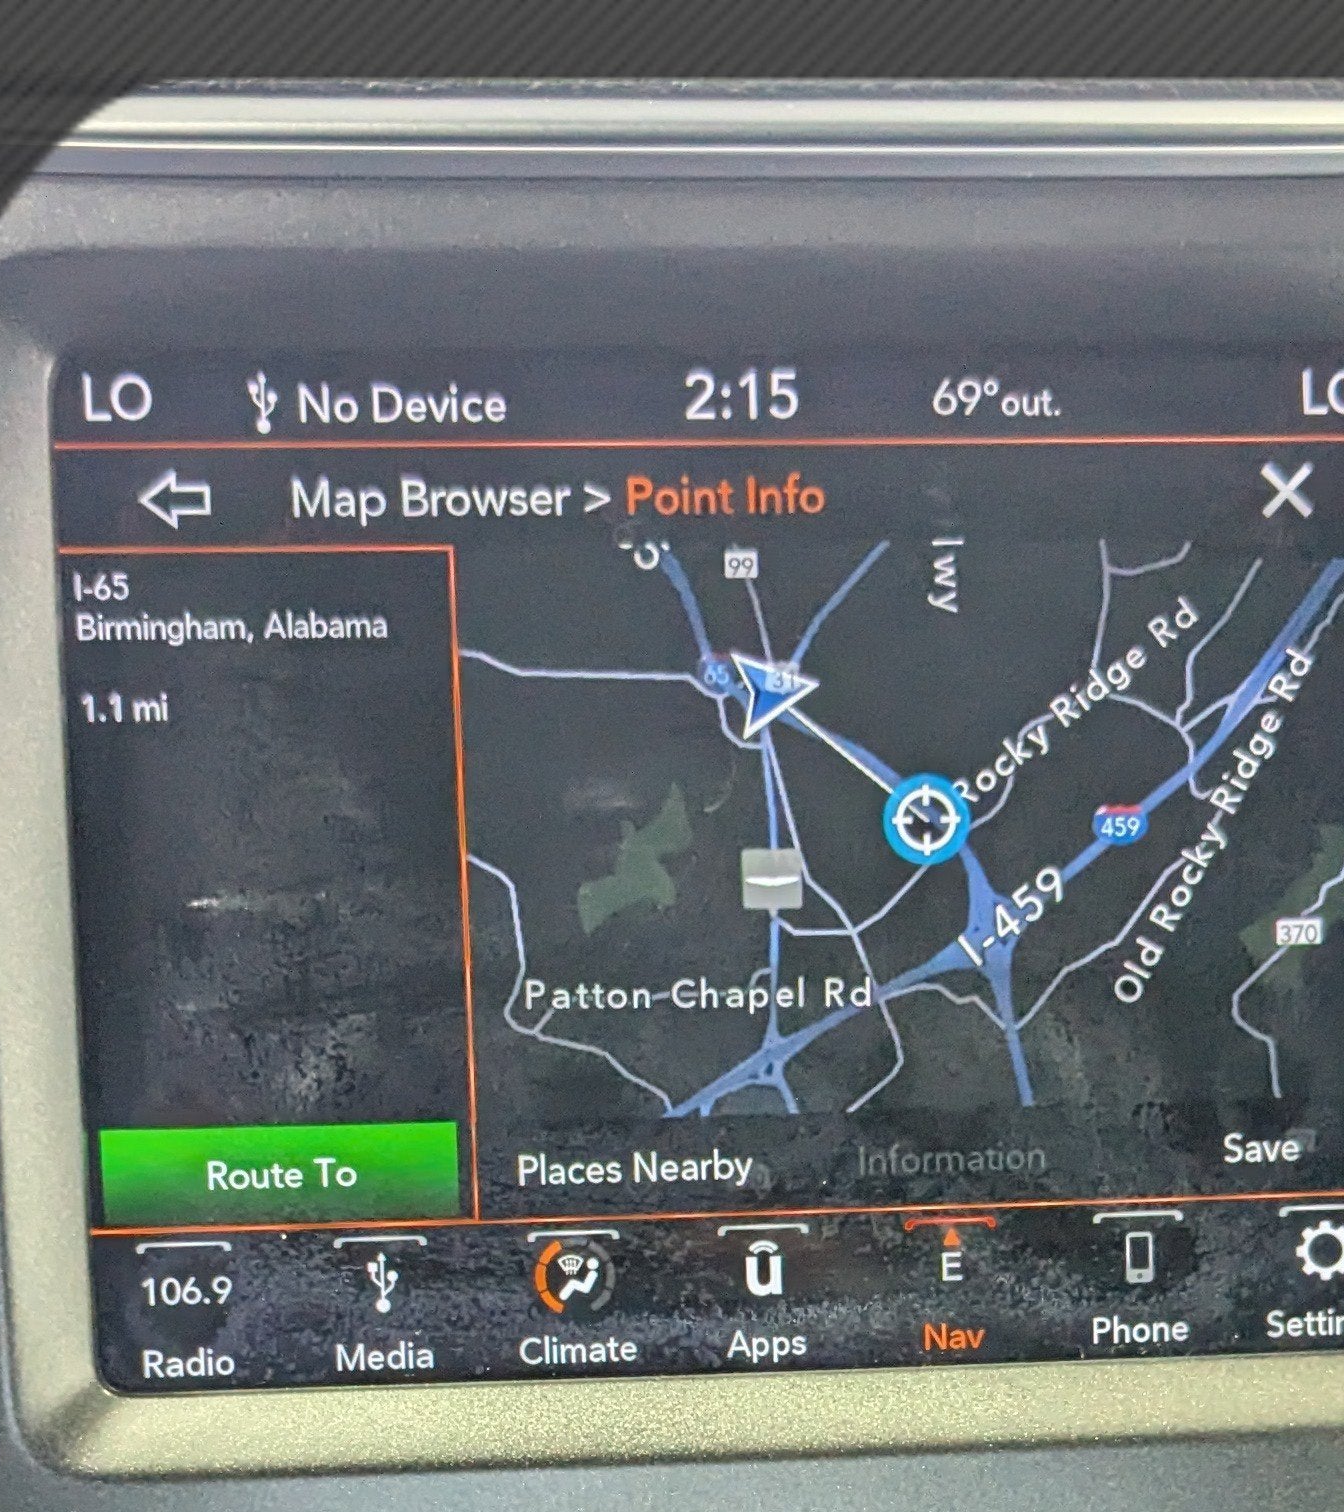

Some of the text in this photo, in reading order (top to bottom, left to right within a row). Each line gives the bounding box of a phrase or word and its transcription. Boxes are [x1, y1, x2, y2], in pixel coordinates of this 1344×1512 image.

[82, 372, 153, 422] LO
[298, 382, 507, 424] No Device
[685, 368, 799, 420] 2:15
[291, 476, 387, 527] Map
[401, 476, 572, 517] Browser
[627, 475, 734, 516] Point
[747, 472, 825, 514] Info
[728, 556, 755, 577] 99
[73, 572, 130, 602] I-65
[76, 610, 388, 646] Birmingham, Alabama
[82, 692, 168, 723] 1.1 mi
[953, 595, 1200, 804] Rocky Ridge Rd
[1100, 817, 1141, 839] 459
[1113, 646, 1313, 1003] Old Rocky Ridge Rd
[957, 865, 1064, 967] I-459
[1280, 924, 1318, 944] 370
[524, 976, 873, 1015] Patton Chapel Rd
[857, 1145, 1048, 1178] Information
[1223, 1135, 1300, 1165] Save
[206, 1157, 358, 1191] Route To
[517, 1148, 754, 1187] Places Nearby
[940, 1251, 964, 1283] E
[140, 1276, 233, 1307] 106.9
[923, 1323, 986, 1351] Nav
[1092, 1316, 1190, 1345] Phone
[335, 1342, 435, 1372] Media
[519, 1336, 638, 1365] Climate
[727, 1331, 808, 1363] Apps
[142, 1350, 235, 1379] Radio
